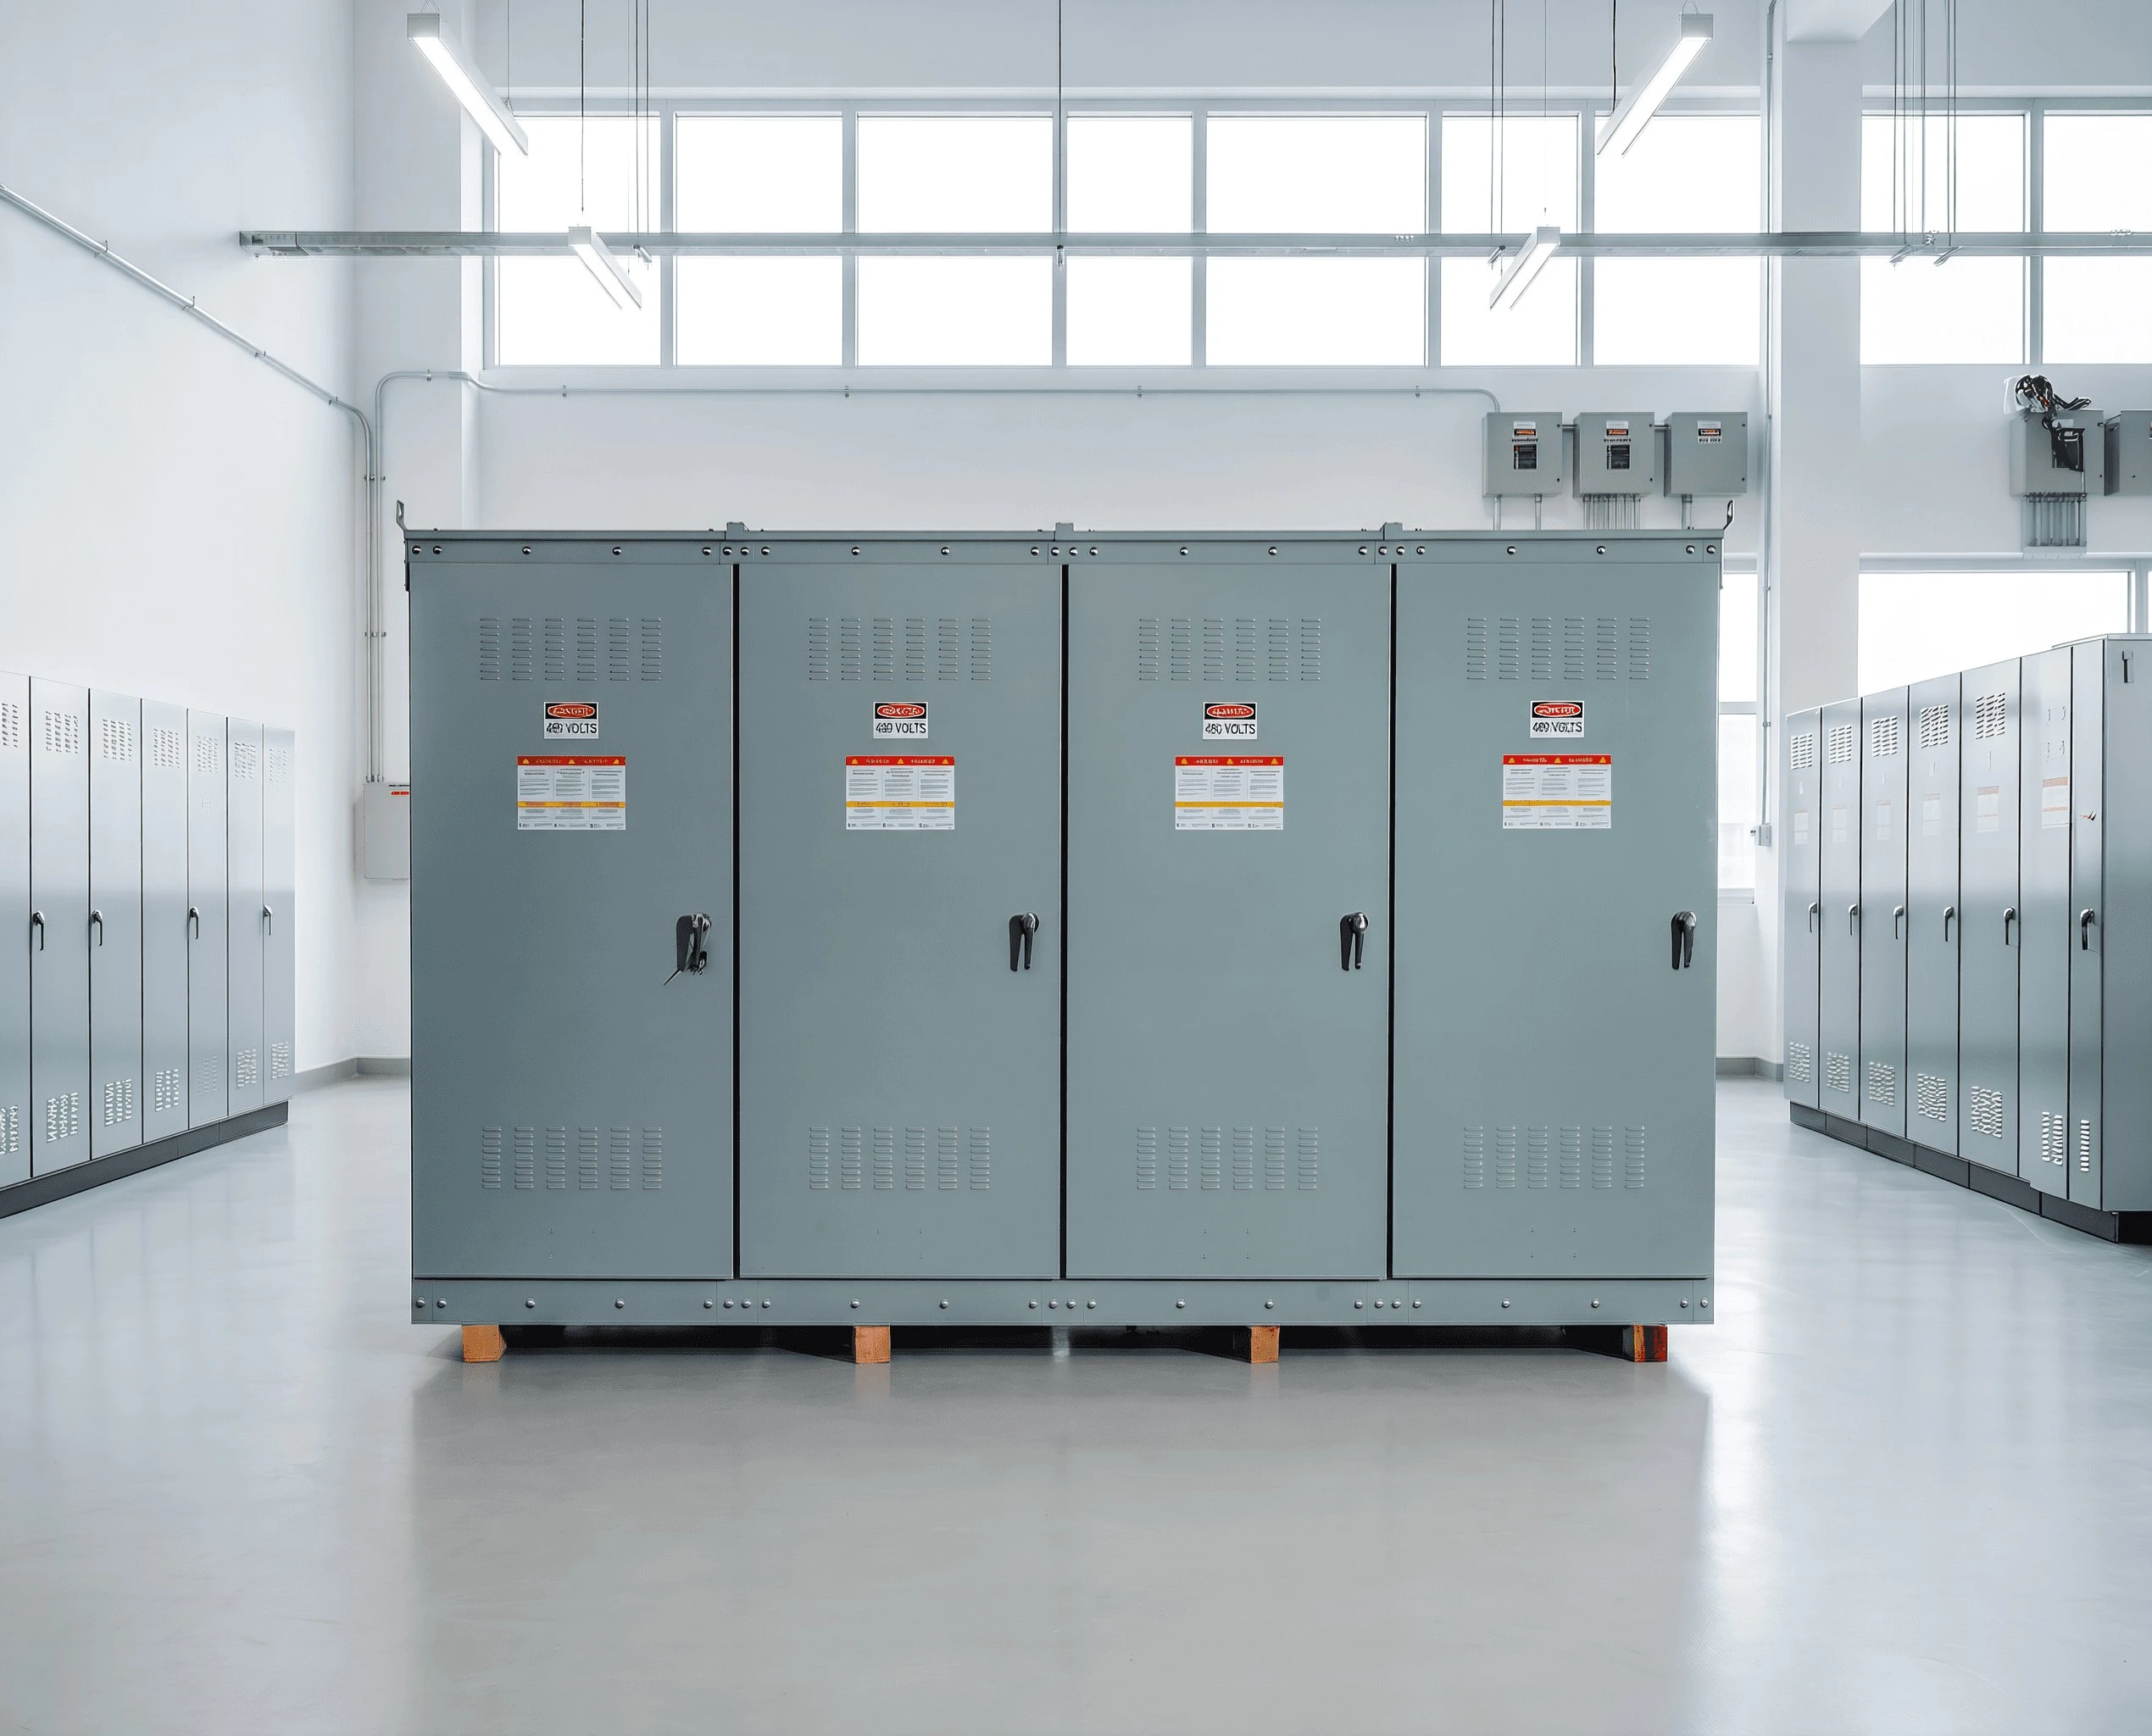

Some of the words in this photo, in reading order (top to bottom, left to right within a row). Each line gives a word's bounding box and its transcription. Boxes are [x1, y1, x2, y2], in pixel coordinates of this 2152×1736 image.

[565, 722, 598, 733] VOLTS
[895, 722, 926, 733] VOLTS
[1224, 723, 1256, 734] VOLTS
[1551, 721, 1582, 732] VOLTS
